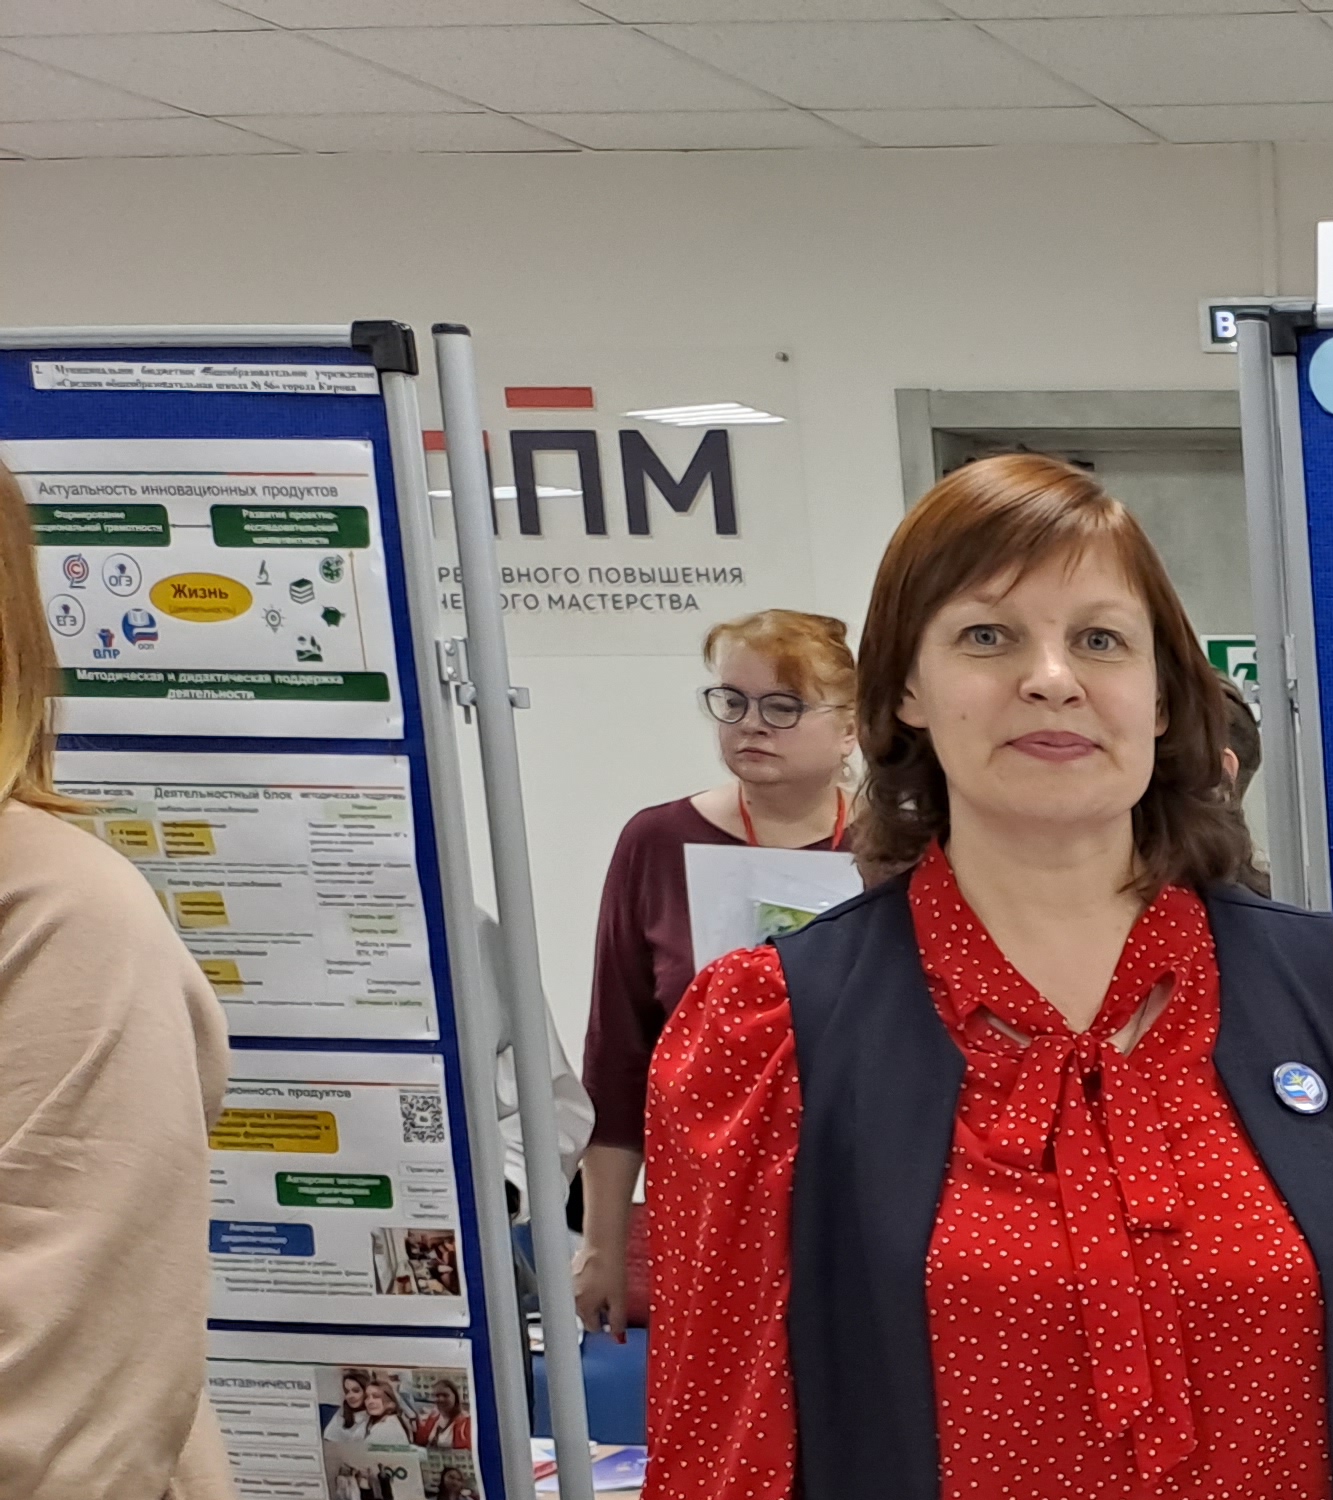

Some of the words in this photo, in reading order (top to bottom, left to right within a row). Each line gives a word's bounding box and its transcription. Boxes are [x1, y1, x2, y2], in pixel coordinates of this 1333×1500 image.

[39, 482, 137, 500] Актуальность
[141, 482, 257, 499] инновационных
[262, 482, 338, 499] продуктов
[589, 566, 743, 584] ПОВЫШЕНИЯ
[171, 583, 229, 600] Жизнь
[549, 593, 699, 612] МАСТЕРСТВА
[93, 647, 120, 660] ВПР
